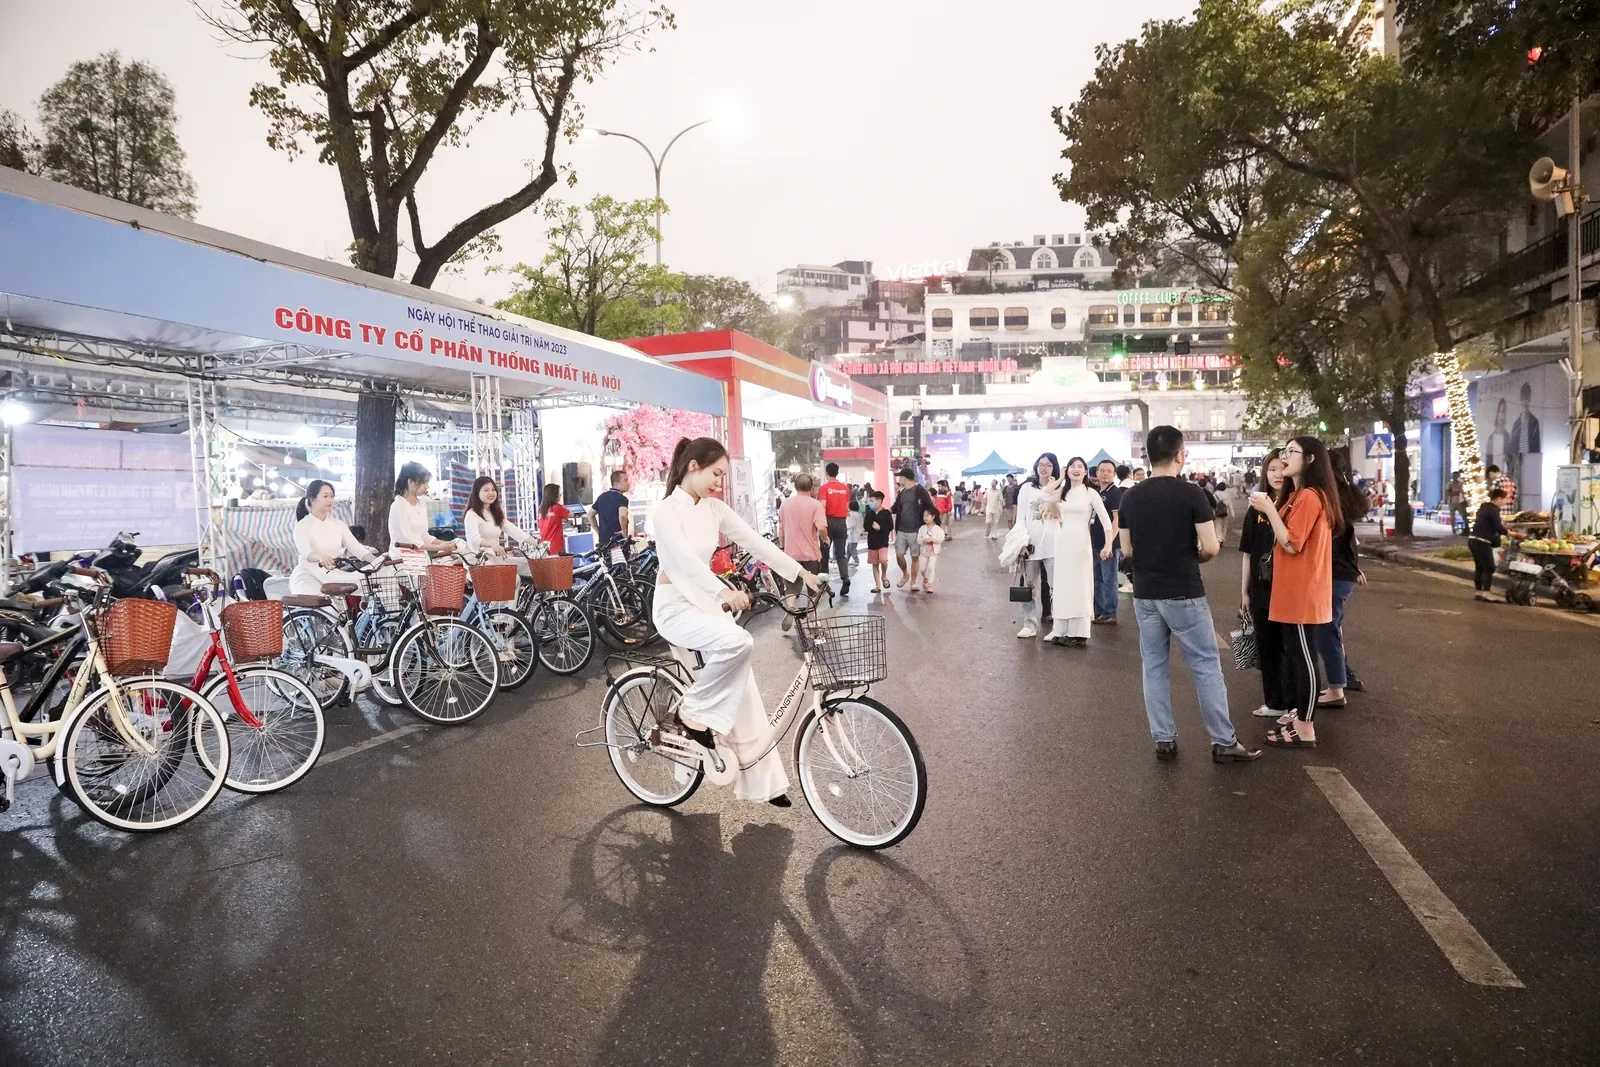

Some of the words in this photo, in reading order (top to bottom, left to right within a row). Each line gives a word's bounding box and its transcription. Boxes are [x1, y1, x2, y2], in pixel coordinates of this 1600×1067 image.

[886, 258, 967, 280] viettel
[1117, 292, 1150, 304] COFFEE
[407, 304, 436, 325] NGÀY
[437, 310, 456, 332] HỘI
[457, 312, 476, 334] THỂ
[477, 322, 501, 341] THAO
[502, 325, 519, 343] GIẢI
[520, 329, 532, 346] TRÍ
[533, 333, 550, 350] NĂM
[551, 341, 567, 355] 2023
[274, 305, 352, 340] CÔNG
[359, 323, 387, 346] TY
[394, 327, 424, 352] CỔ
[430, 338, 483, 364] PHẦN
[487, 348, 540, 375] THỐNG
[544, 361, 579, 383] NHẤT
[582, 365, 598, 387] HÀ
[601, 373, 621, 392] NỘI
[958, 360, 975, 372] NAM
[1187, 356, 1204, 368] NAM
[769, 674, 805, 728] THONGNHAT
